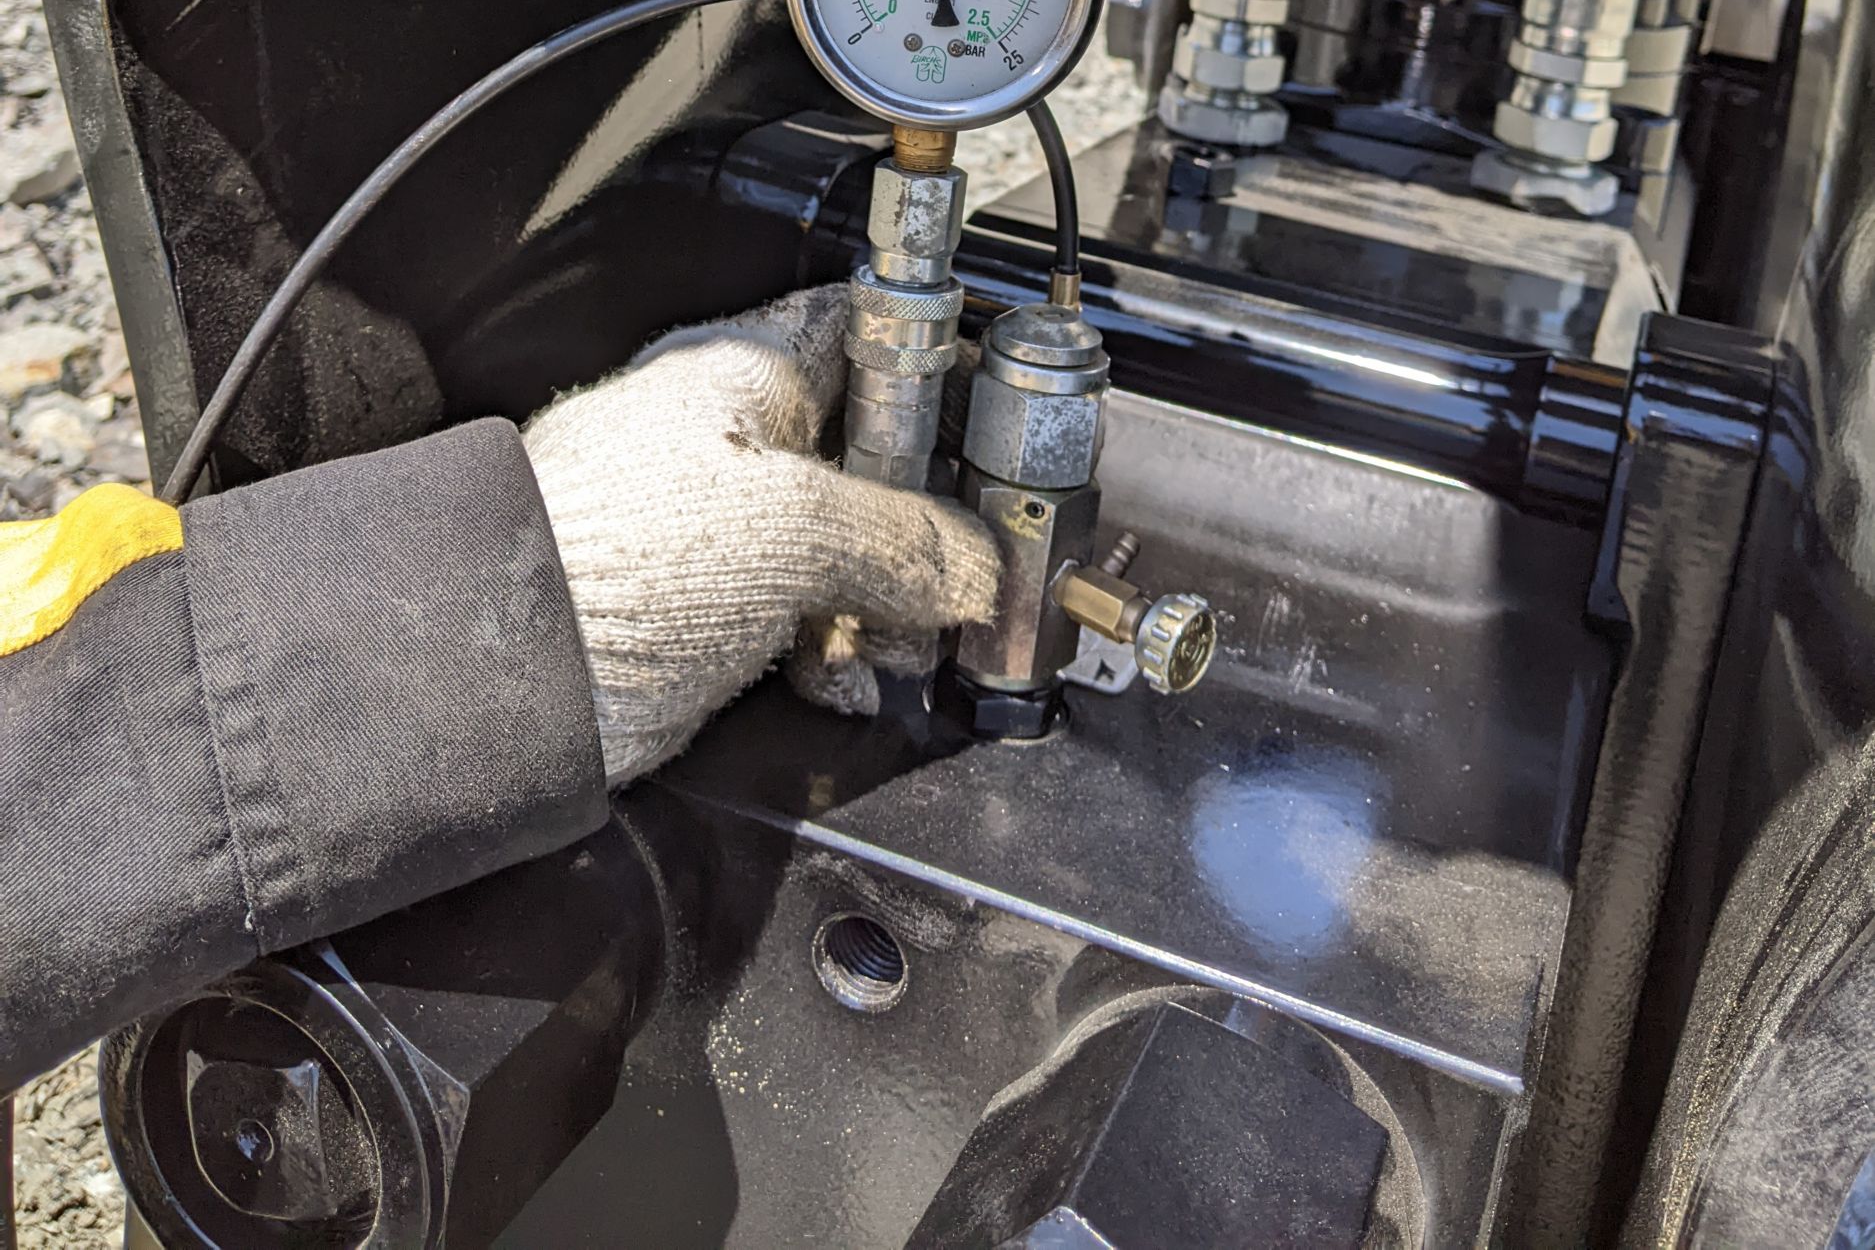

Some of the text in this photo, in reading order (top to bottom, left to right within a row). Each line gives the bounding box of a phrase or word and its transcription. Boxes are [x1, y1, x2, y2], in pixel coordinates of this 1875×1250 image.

[967, 8, 991, 26] 2.5
[847, 32, 862, 45] 0
[965, 44, 986, 58] BAR
[1003, 50, 1025, 71] 25
